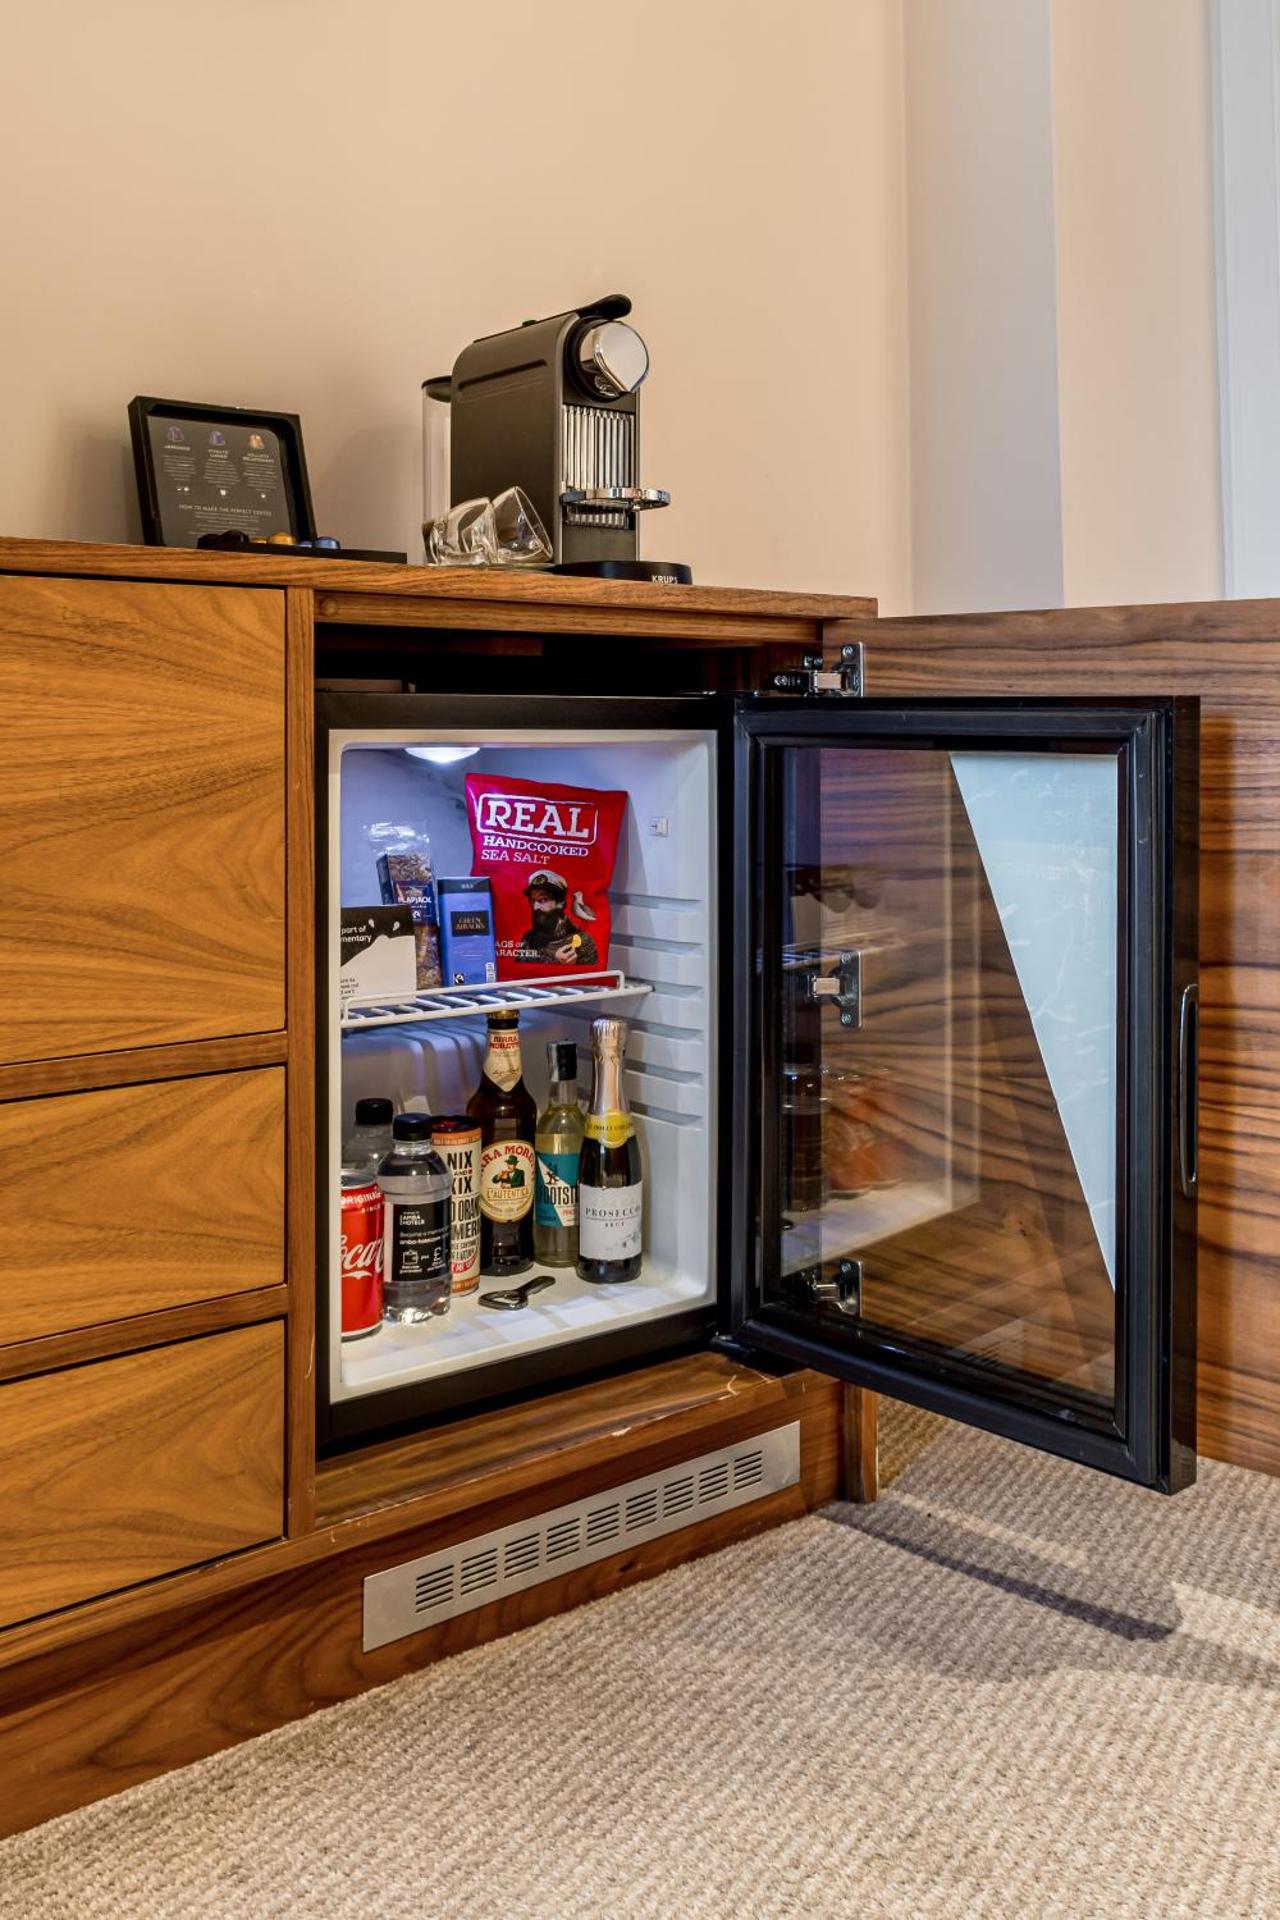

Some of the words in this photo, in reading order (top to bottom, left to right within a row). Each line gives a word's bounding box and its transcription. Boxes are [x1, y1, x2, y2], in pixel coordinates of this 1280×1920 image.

[652, 575, 678, 585] KRUPS
[485, 800, 590, 838] REAL
[483, 835, 590, 857] HANDCOOKED
[481, 849, 510, 861] SEA
[513, 851, 551, 865] SALT
[358, 925, 367, 933] of
[447, 1150, 473, 1170] NIX
[584, 1205, 640, 1218] PROSECCO
